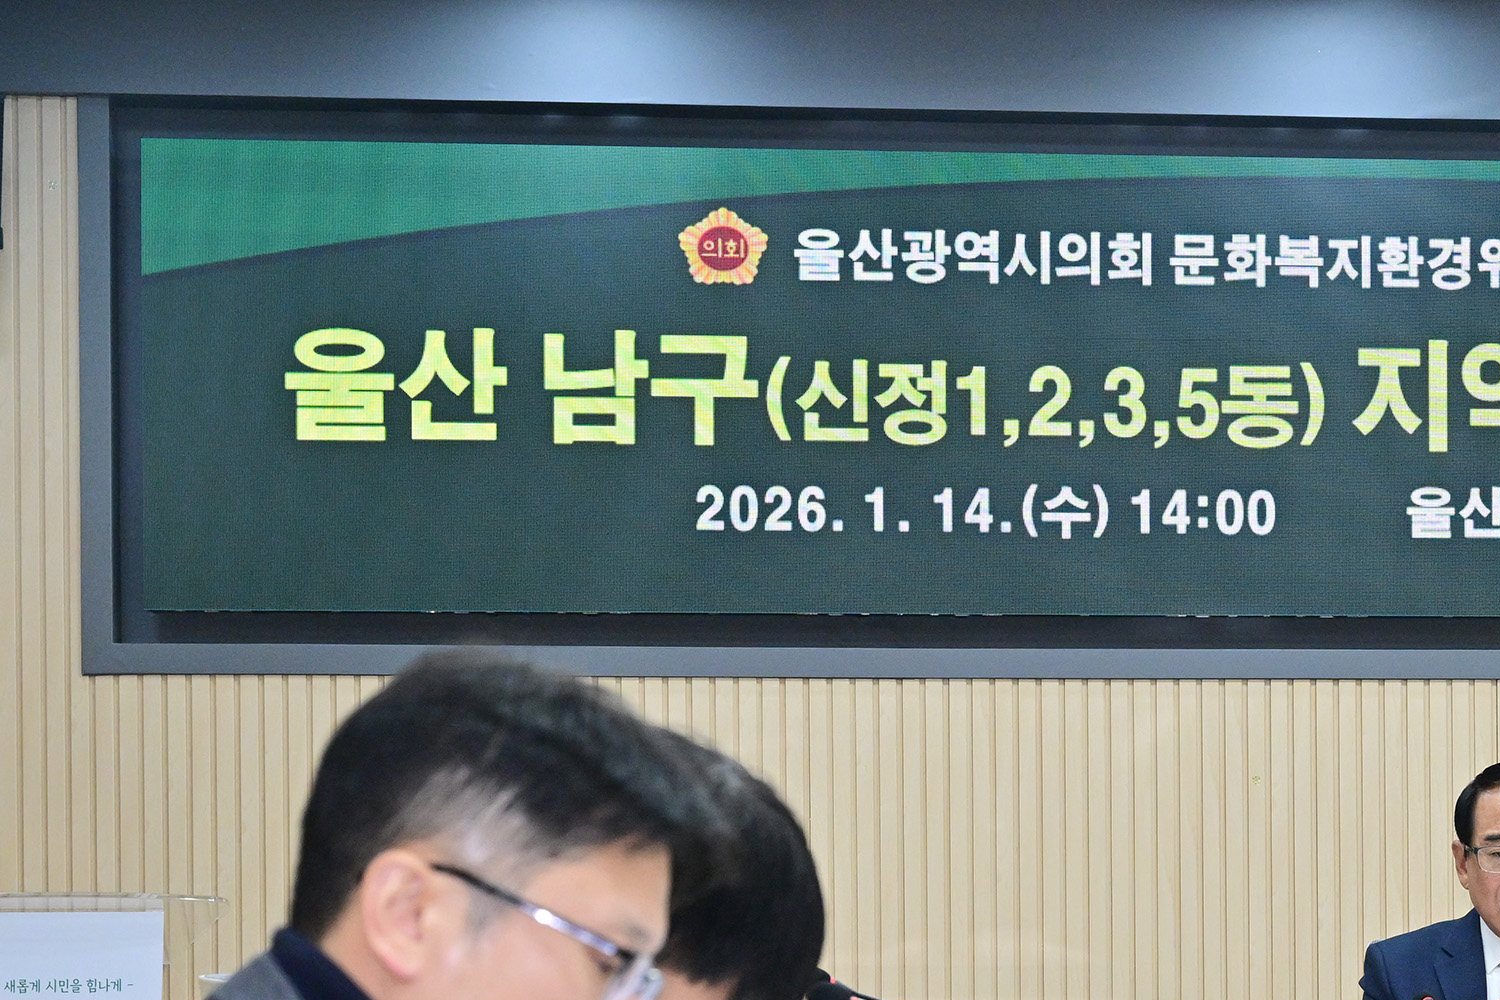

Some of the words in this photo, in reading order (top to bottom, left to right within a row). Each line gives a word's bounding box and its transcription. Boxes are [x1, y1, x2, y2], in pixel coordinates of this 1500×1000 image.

[700, 237, 745, 259] 의회
[794, 228, 1153, 286] 울산광역시의회
[284, 327, 508, 443] 울산
[695, 485, 844, 533] 2026.
[865, 488, 911, 533] 1.
[1130, 488, 1277, 537] 14:00
[4, 979, 41, 994] 새롭게
[46, 979, 82, 993] 시민을
[86, 978, 122, 993] 힘나게
